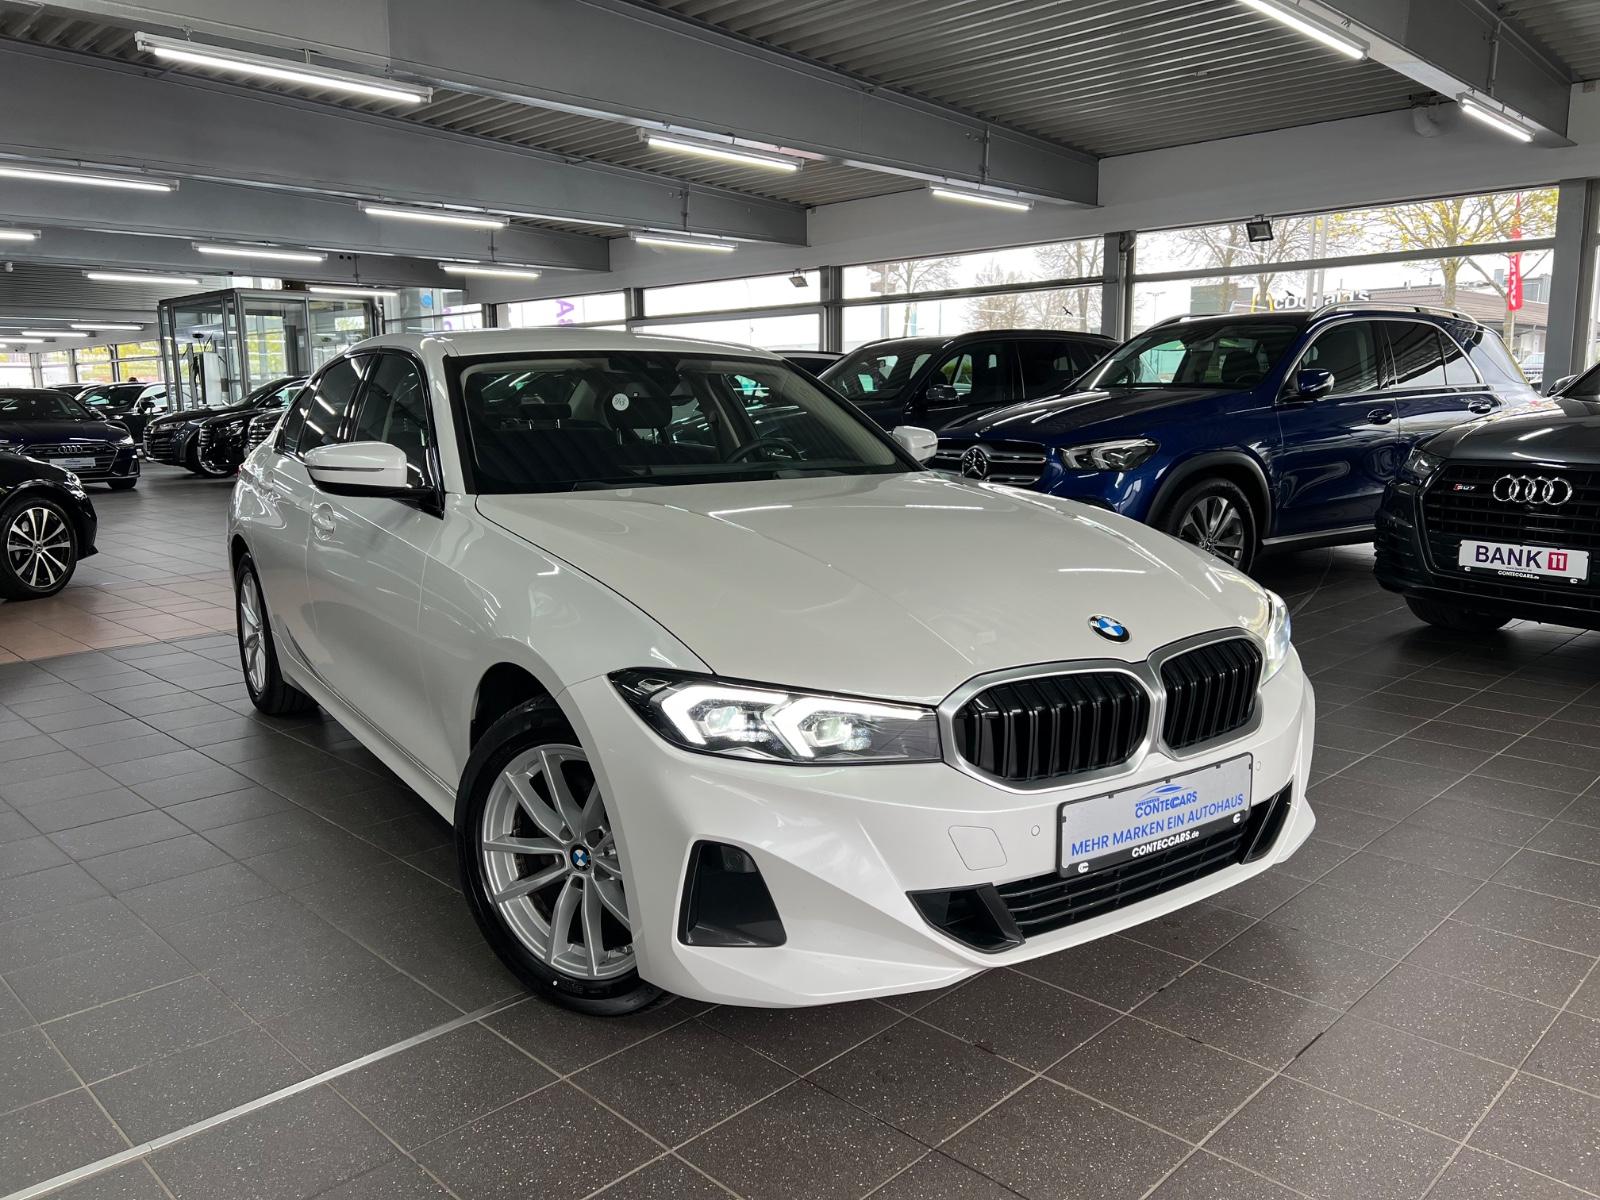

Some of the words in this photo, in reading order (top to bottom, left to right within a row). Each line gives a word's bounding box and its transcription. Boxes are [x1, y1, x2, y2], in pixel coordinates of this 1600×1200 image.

[1475, 544, 1543, 569] BANK
[1550, 553, 1566, 570] 11
[1071, 834, 1109, 857] MEHR
[1113, 821, 1164, 846] MARKEN
[1167, 813, 1185, 830] EIN
[1187, 793, 1244, 823] AUTOHAUS
[1131, 830, 1200, 858] CONTECCARS.de
